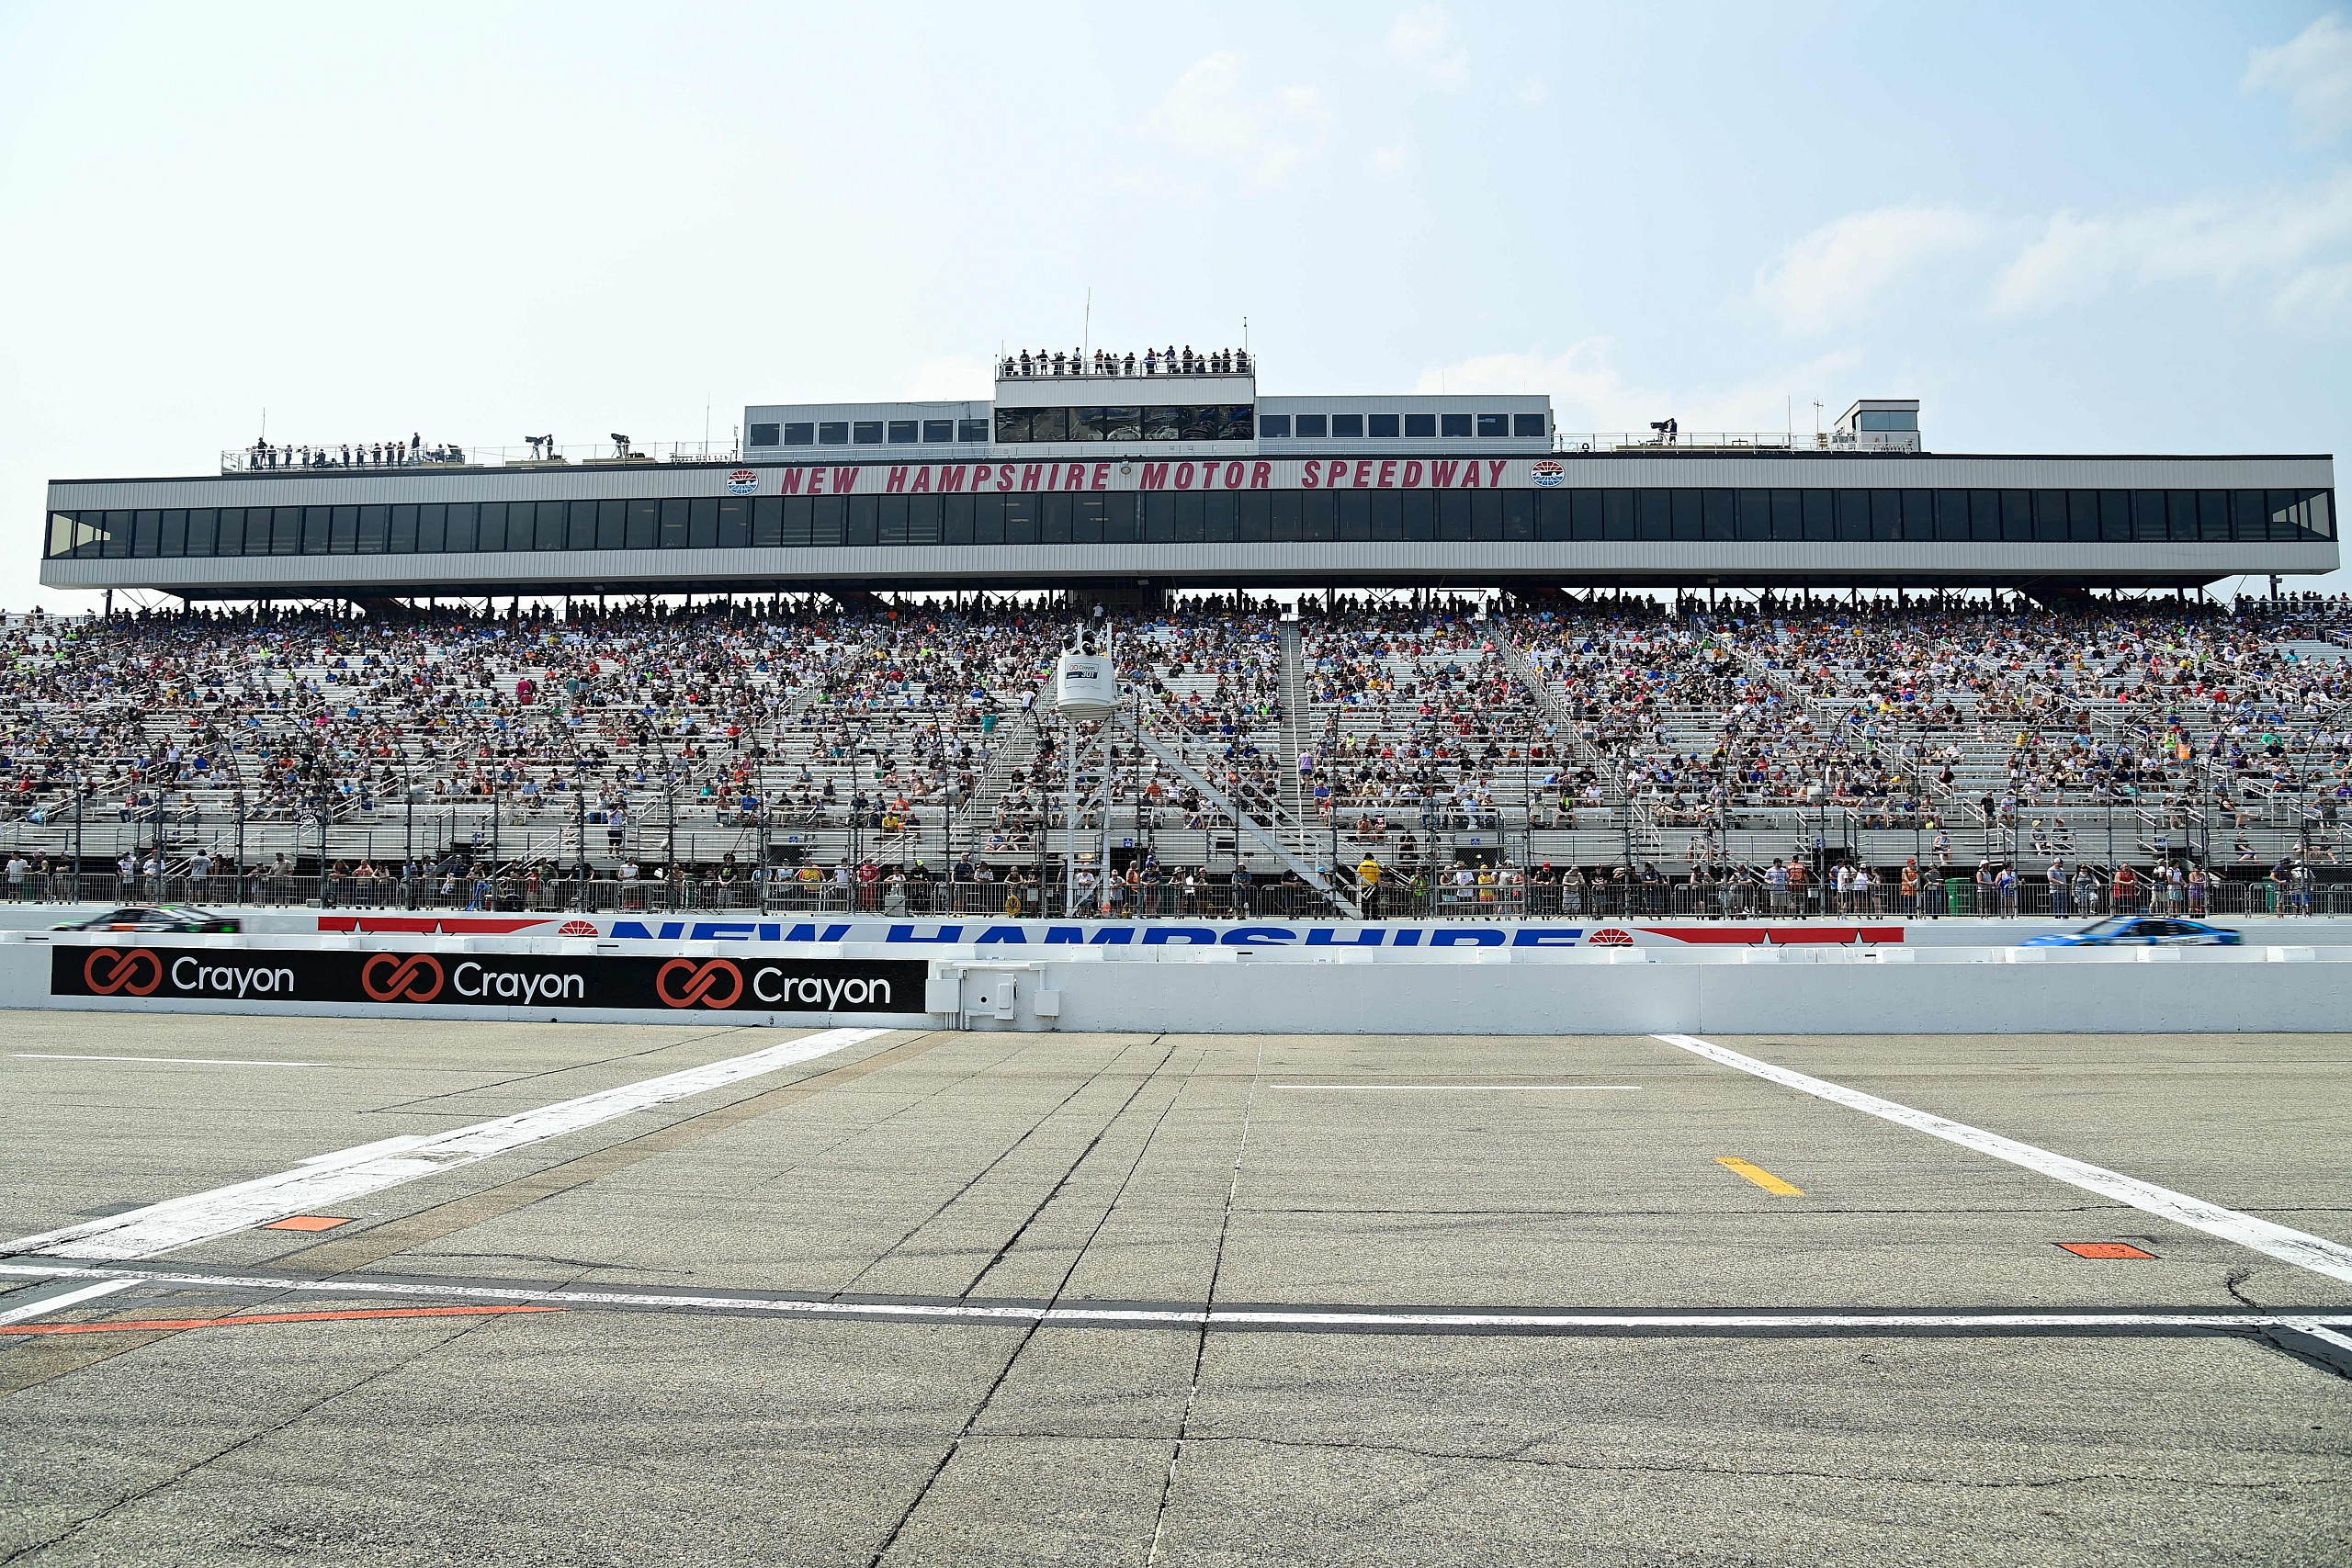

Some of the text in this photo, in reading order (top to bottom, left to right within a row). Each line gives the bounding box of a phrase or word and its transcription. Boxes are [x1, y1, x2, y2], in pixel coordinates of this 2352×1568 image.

[782, 460, 1507, 494] NEW HAMPSHIRE MOTOR SPEEDWAY
[171, 956, 295, 998] Crayon
[453, 961, 584, 1005] Crayon
[752, 966, 891, 1010] Crayon
